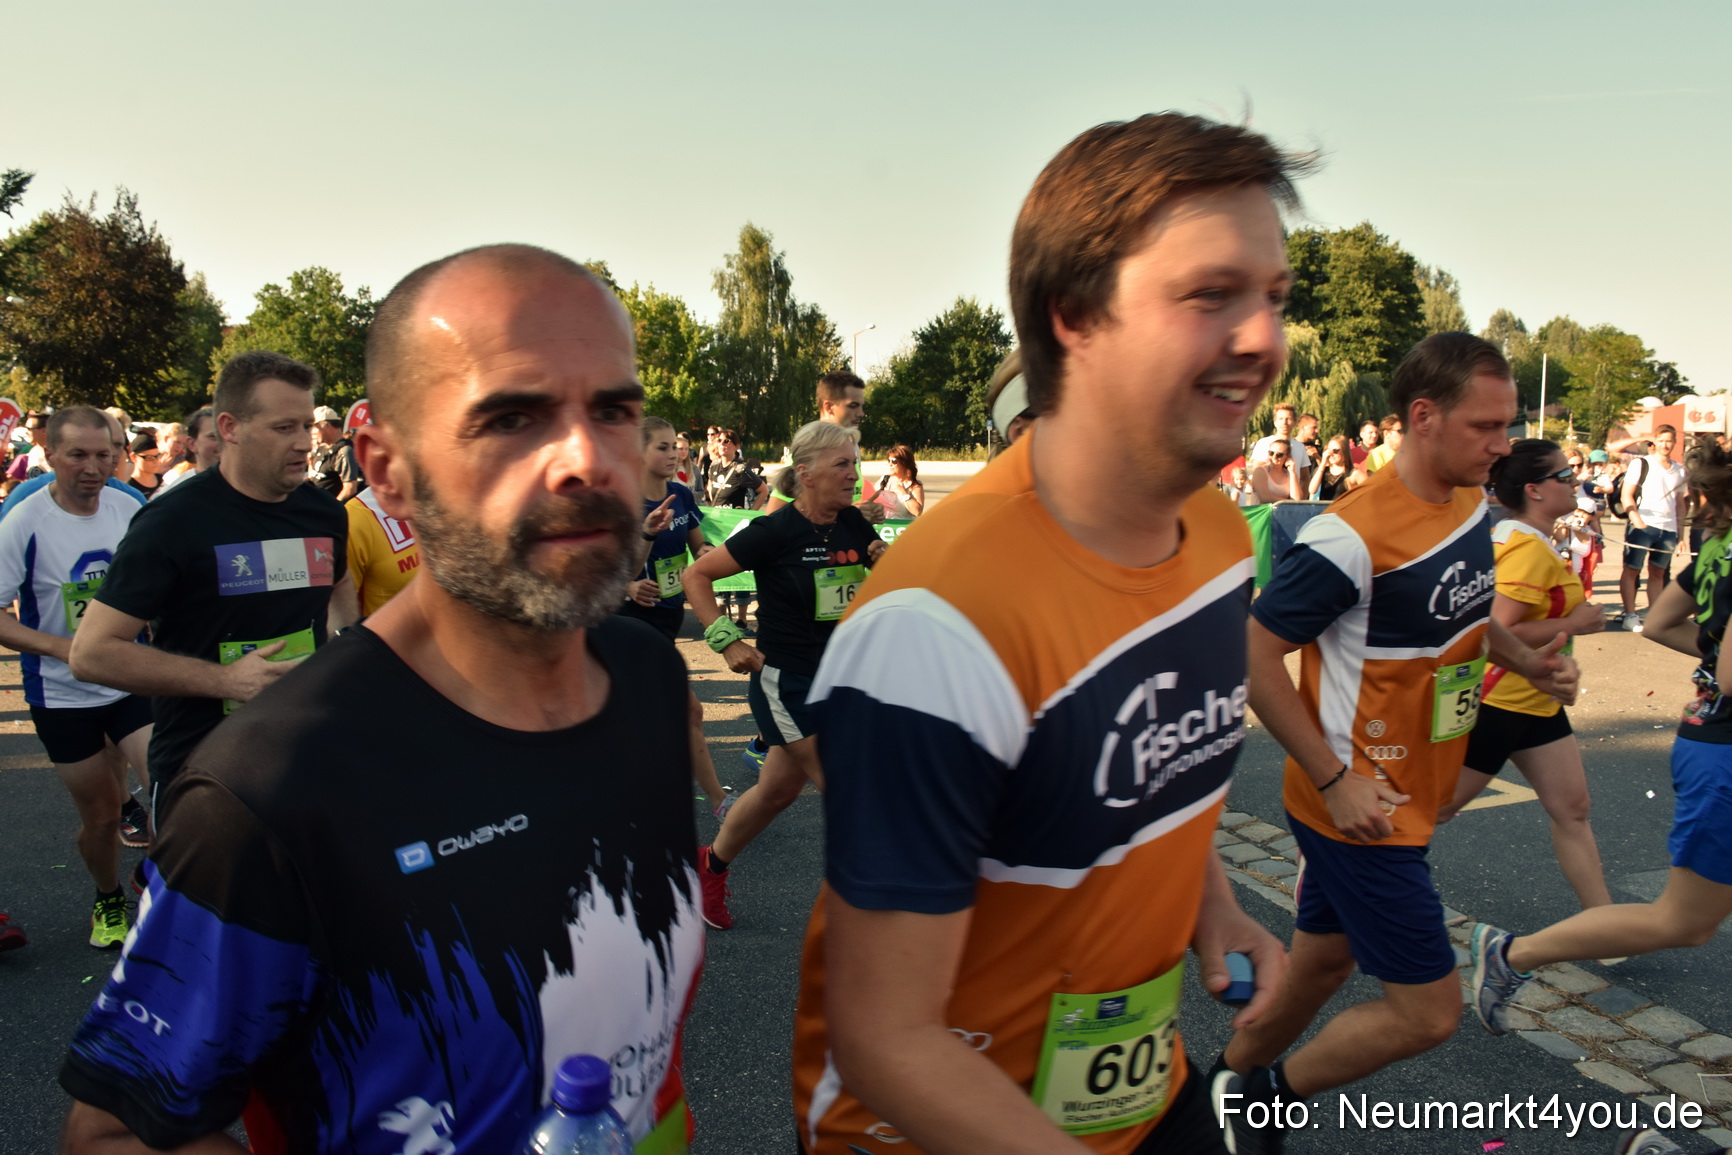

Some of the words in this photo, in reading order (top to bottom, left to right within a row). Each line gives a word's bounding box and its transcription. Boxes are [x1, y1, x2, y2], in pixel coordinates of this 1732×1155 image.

[221, 578, 265, 588] PEUGEOT
[268, 568, 307, 583] MÜLLER
[667, 566, 686, 586] 51
[1449, 566, 1496, 612] Fische
[1131, 679, 1249, 786] Fische
